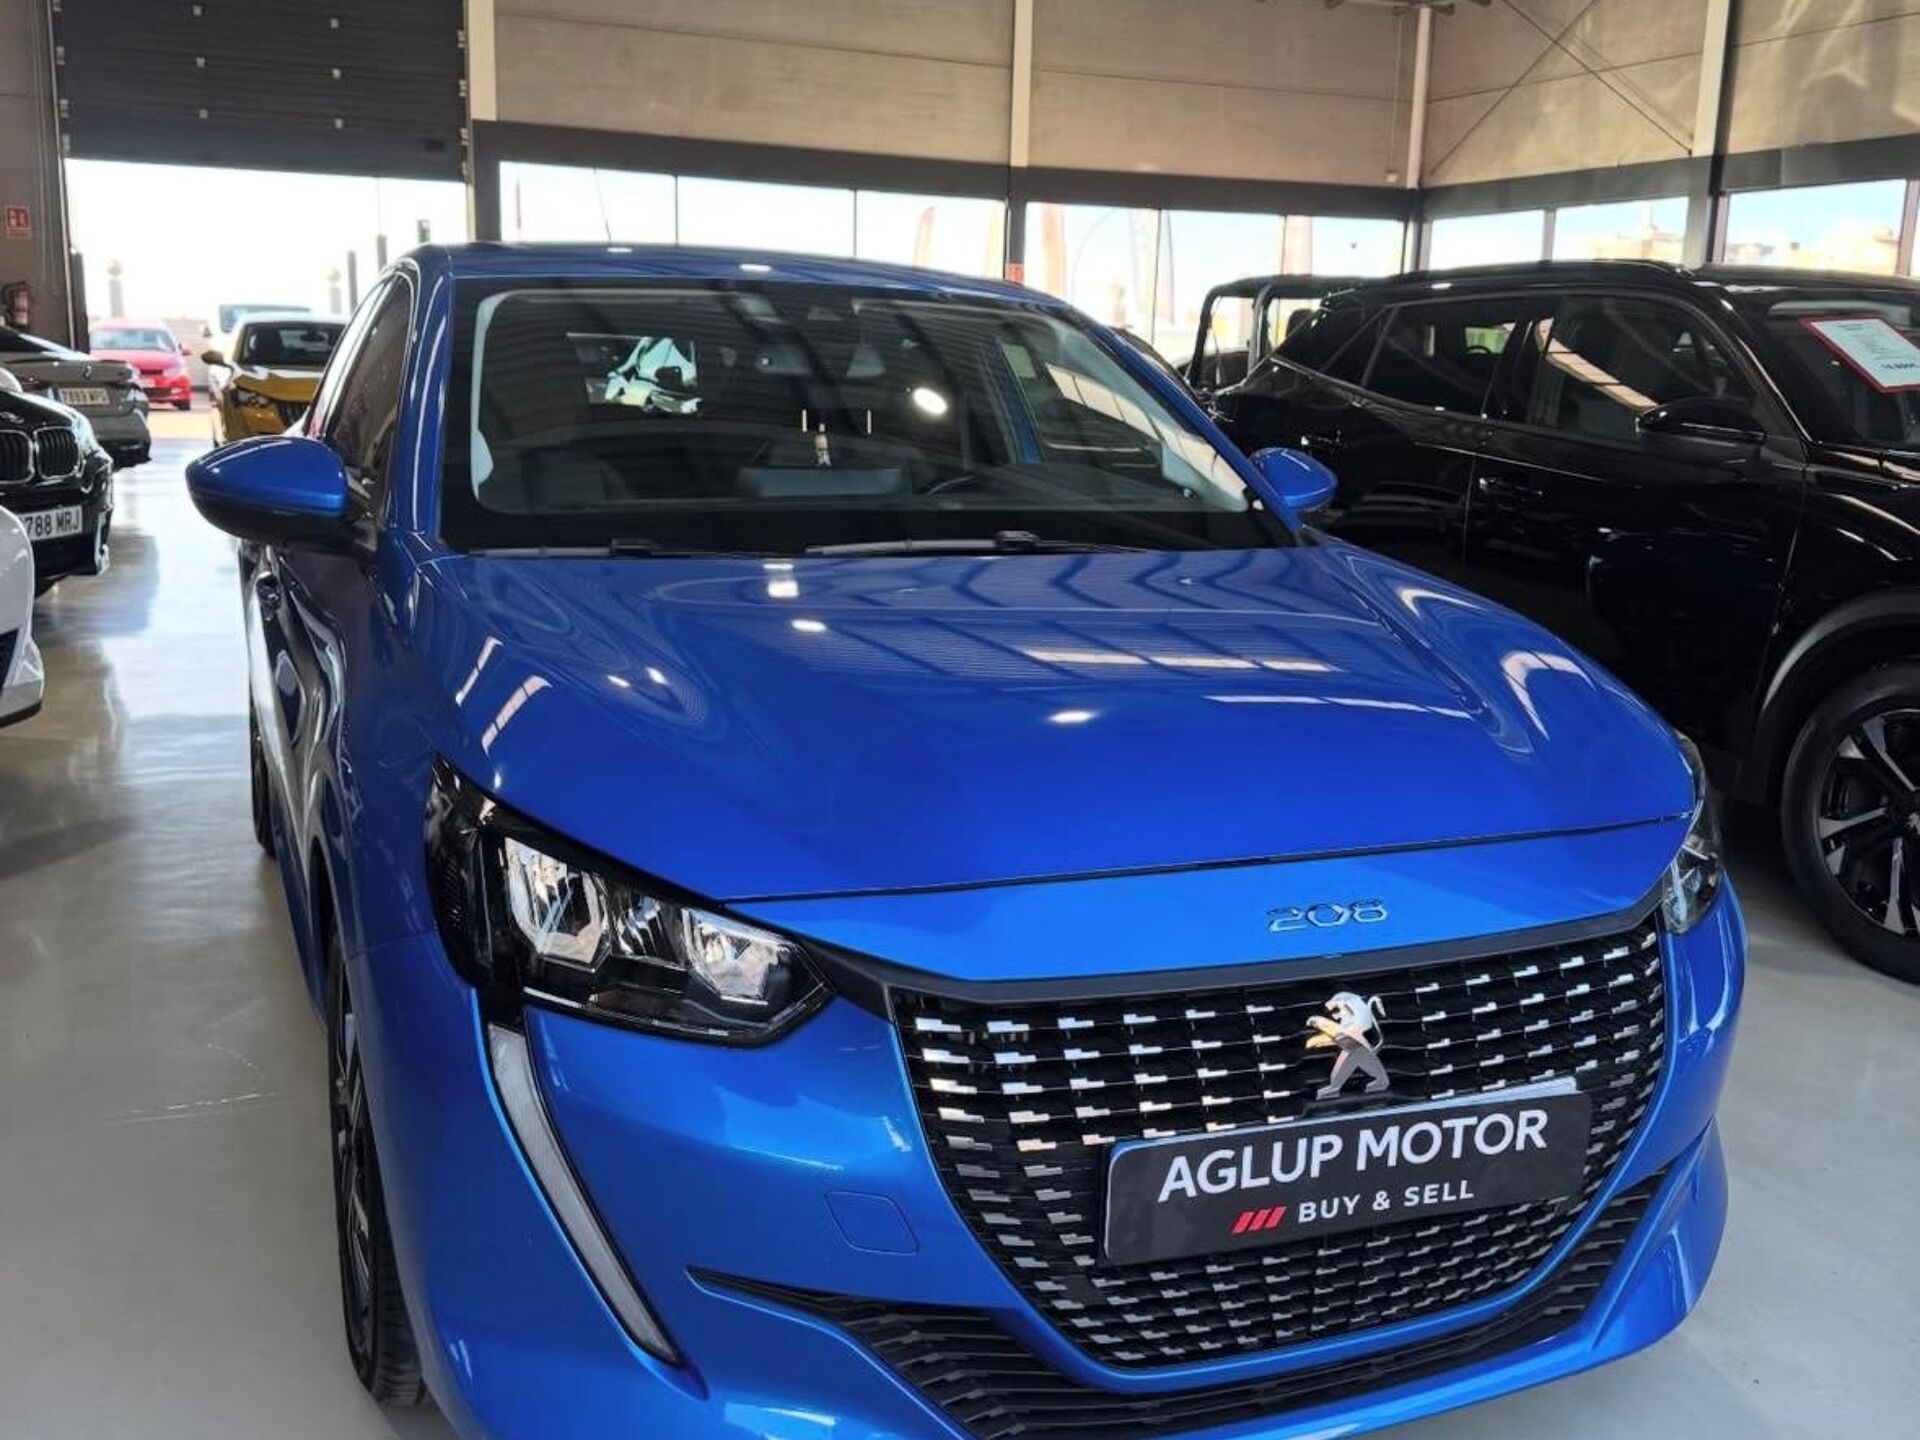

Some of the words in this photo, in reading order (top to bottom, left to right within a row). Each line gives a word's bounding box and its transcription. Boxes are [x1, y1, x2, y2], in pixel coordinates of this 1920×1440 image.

[20, 514, 52, 537] 788
[56, 509, 79, 532] MRJ
[1266, 899, 1388, 932] 208
[1157, 1134, 1343, 1202] AGLUP
[1356, 1109, 1548, 1171] MOTOR
[1297, 1195, 1360, 1222] BUY
[1372, 1190, 1390, 1211] &
[1403, 1179, 1475, 1207] SELL
